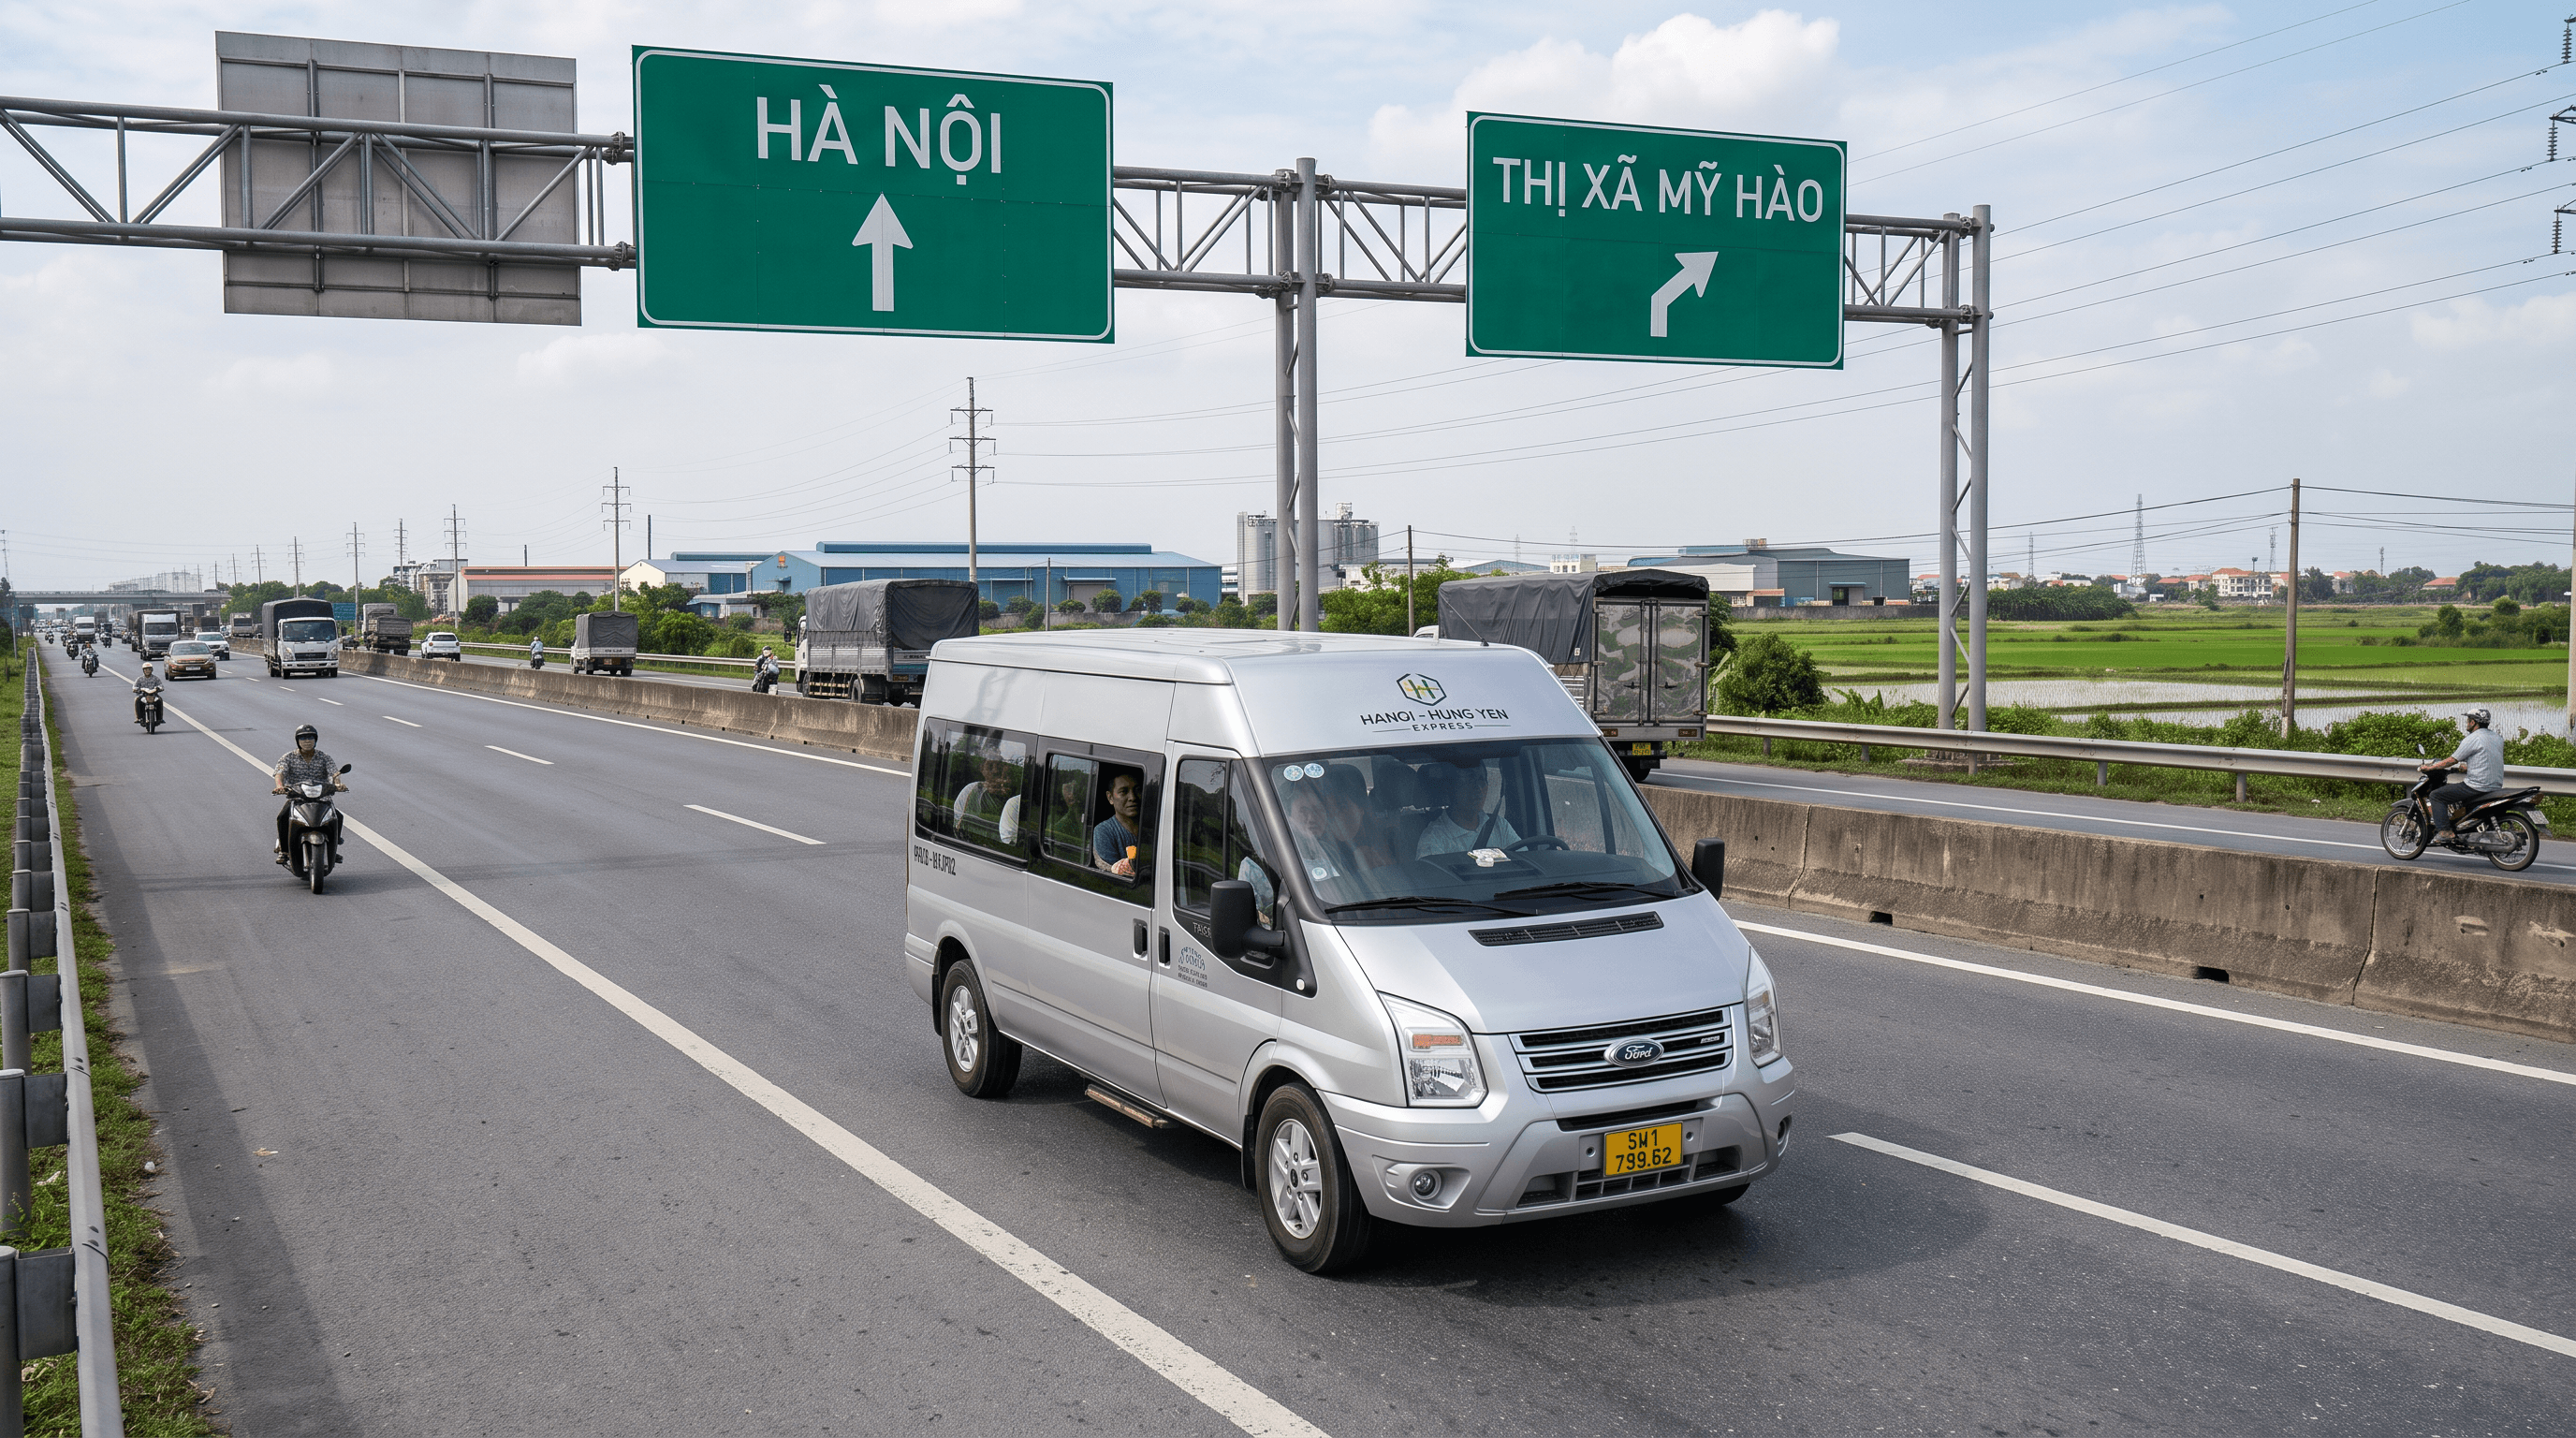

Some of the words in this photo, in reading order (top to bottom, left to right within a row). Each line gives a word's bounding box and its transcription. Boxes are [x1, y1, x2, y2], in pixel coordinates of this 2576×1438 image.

[756, 84, 858, 165] HÀ
[885, 94, 1002, 185] NỘI
[1492, 156, 1566, 217] THỊ
[1581, 154, 1643, 212] XÃ
[1659, 161, 1722, 216] MỸ
[1735, 164, 1823, 223] HÀO
[1360, 711, 1415, 726] HANOI
[1427, 709, 1474, 721] HUNG
[1475, 708, 1509, 720] YEN
[1412, 722, 1473, 732] EXPRESS
[1624, 1045, 1654, 1060] Ford
[1616, 1147, 1672, 1173] 799.62
